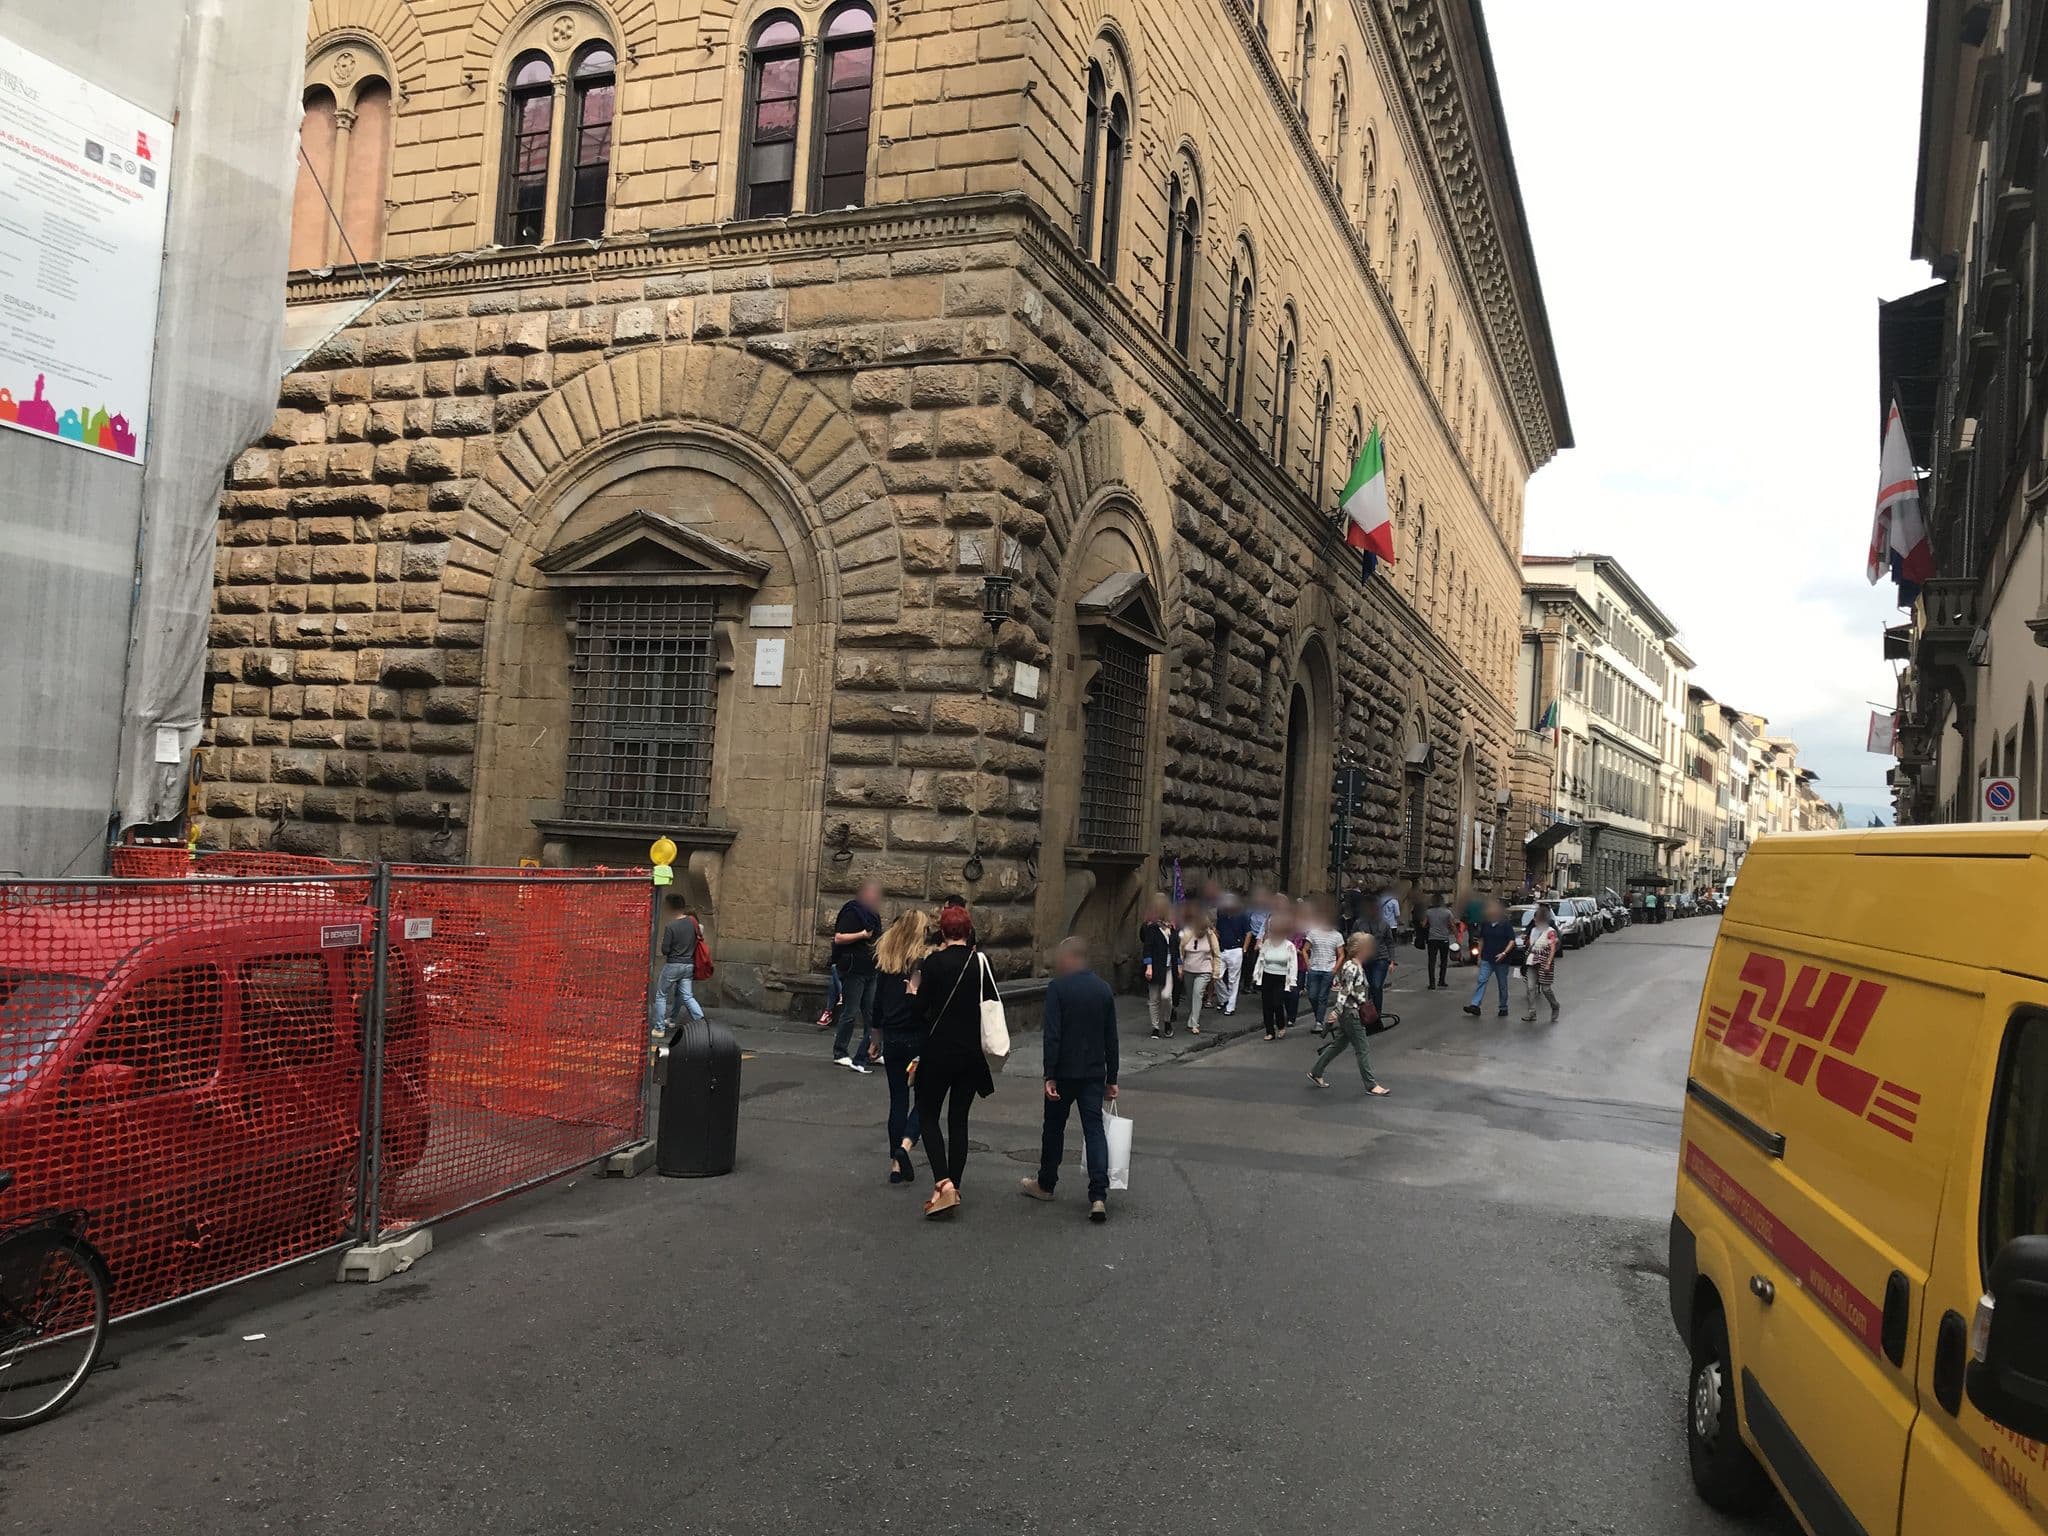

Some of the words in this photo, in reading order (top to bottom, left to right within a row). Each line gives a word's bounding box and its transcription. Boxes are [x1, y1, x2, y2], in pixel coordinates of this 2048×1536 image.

[1722, 951, 1888, 1118] DHL
[1808, 1264, 1868, 1336] www.dhl.com
[2000, 1455, 2033, 1512] DHL
